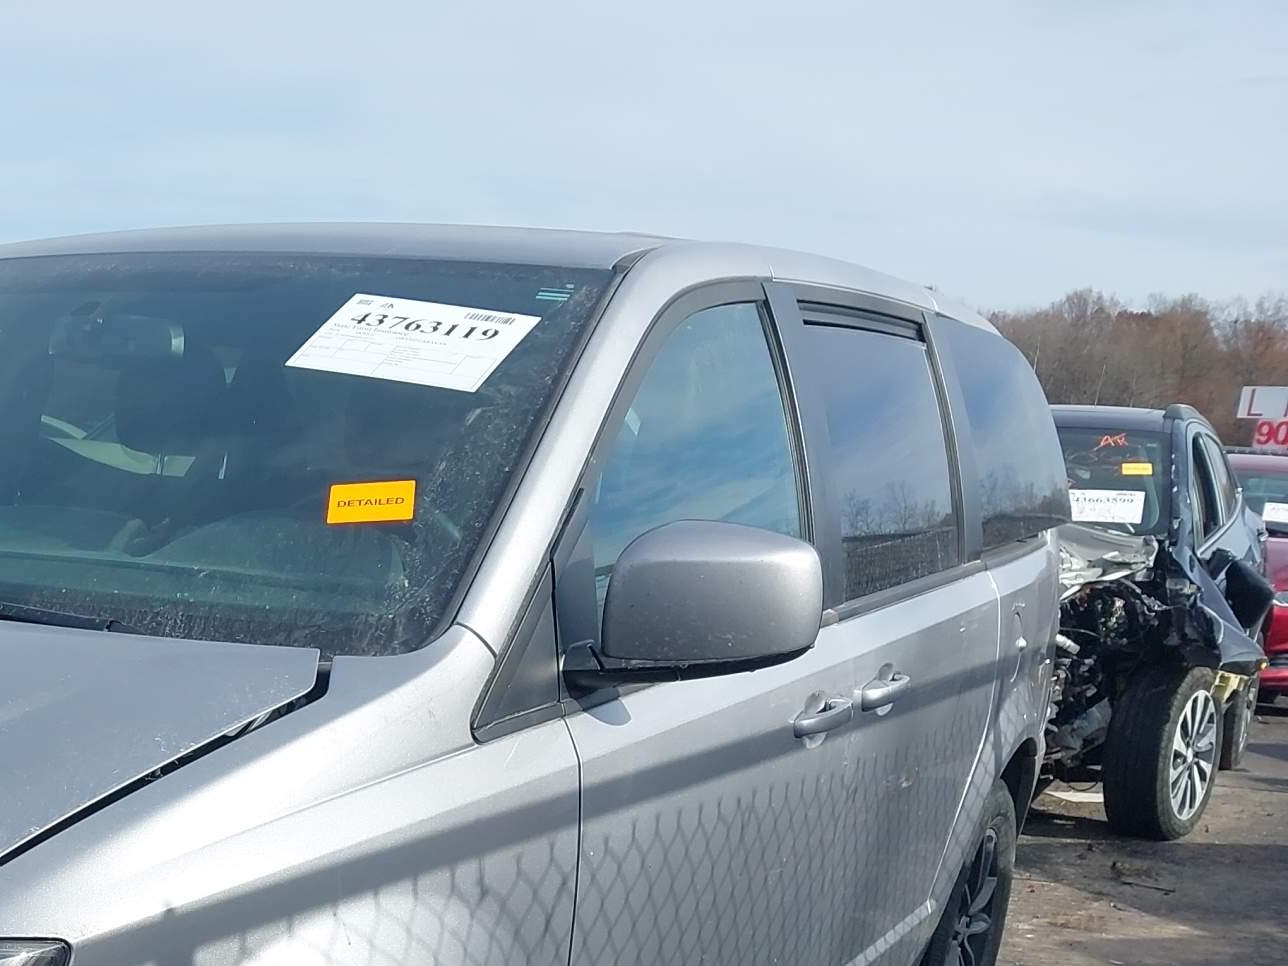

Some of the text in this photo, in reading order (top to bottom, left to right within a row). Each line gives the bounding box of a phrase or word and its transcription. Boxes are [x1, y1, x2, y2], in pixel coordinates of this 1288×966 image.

[350, 311, 500, 341] 43763119
[1247, 388, 1263, 417] L
[1255, 420, 1288, 446] 90
[336, 496, 406, 509] DETAILED
